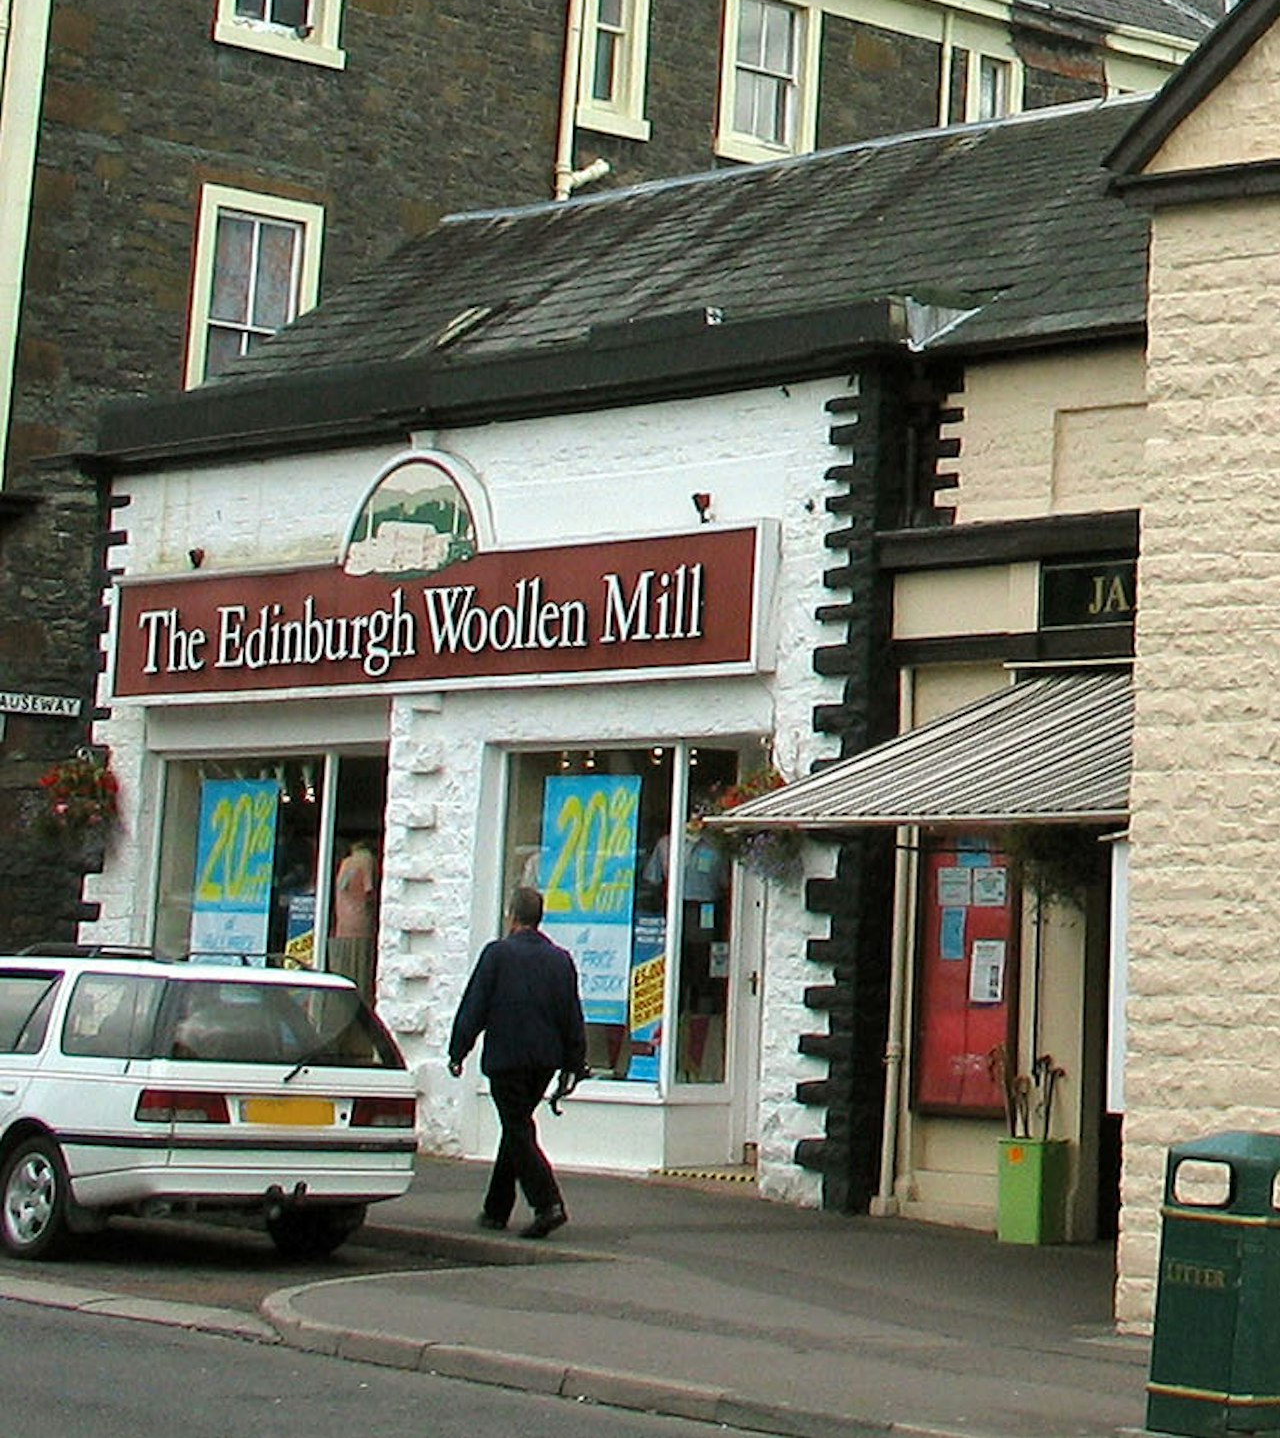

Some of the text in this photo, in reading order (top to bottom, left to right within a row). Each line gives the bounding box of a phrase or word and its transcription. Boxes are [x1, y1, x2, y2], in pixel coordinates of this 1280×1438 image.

[138, 563, 705, 677] The Edinburgh Woollen Mill
[198, 791, 275, 903] 20%
[542, 785, 637, 913] 20%
